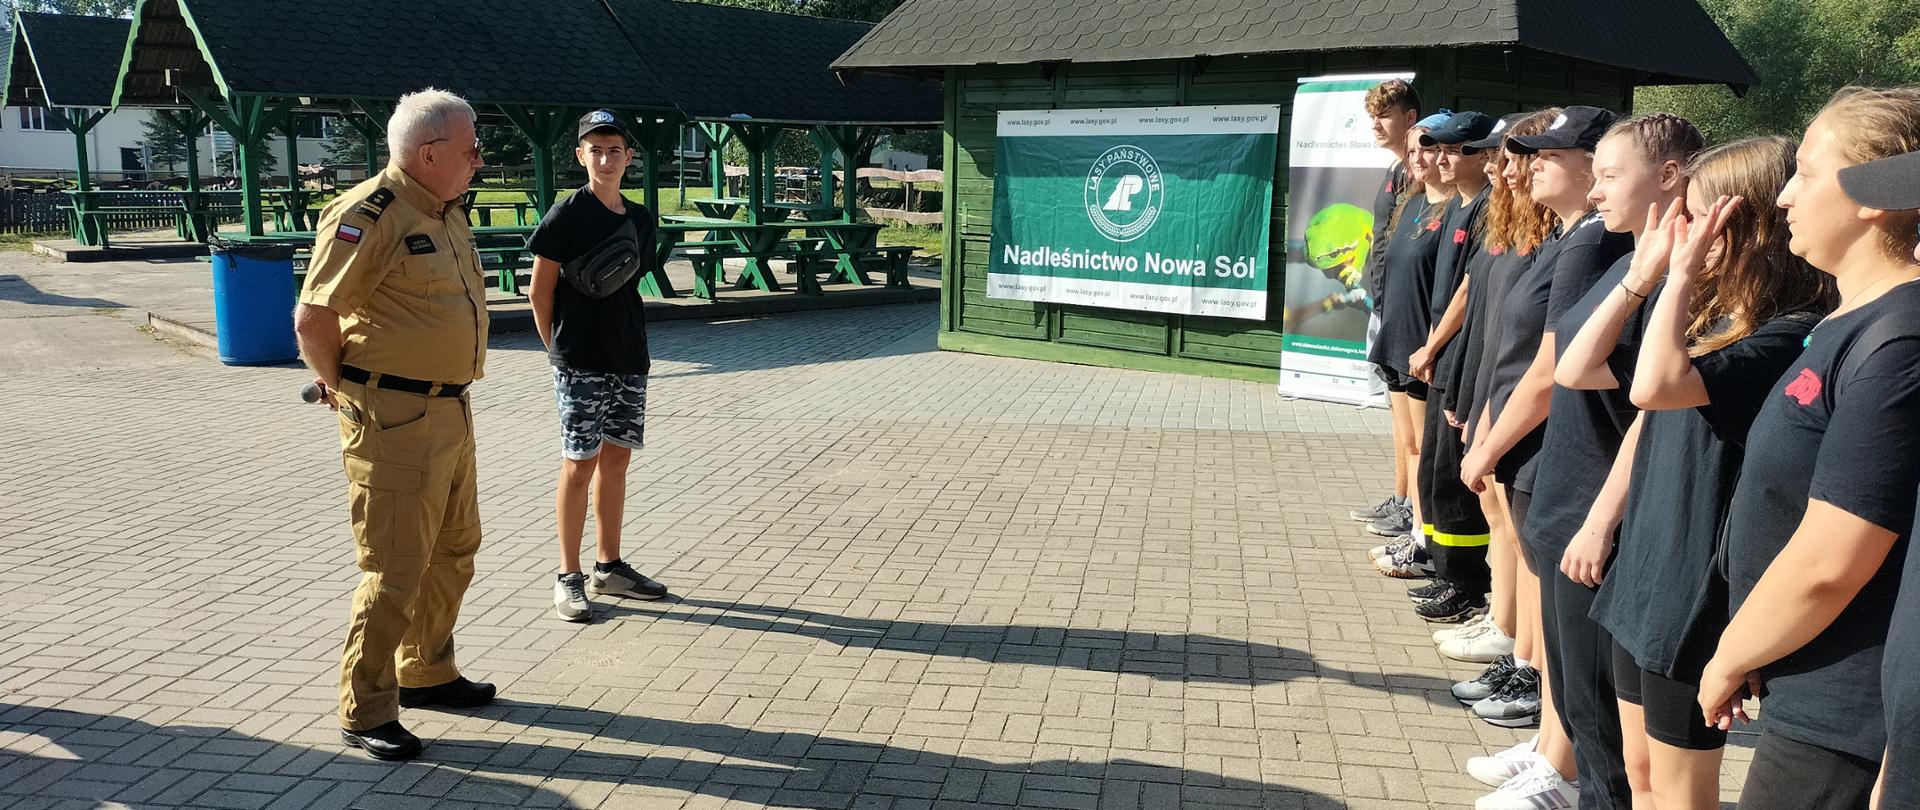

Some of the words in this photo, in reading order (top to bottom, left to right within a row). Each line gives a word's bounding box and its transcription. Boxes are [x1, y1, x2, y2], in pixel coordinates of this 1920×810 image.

[1007, 119, 1051, 127] www.lasy.gov.pl
[1069, 117, 1118, 126] www.lasy.gov.pl
[1138, 115, 1190, 125] www.lasy.gov.pl
[1212, 114, 1268, 123] www.lasy.gov.pl
[1088, 160, 1107, 191] LASY
[1106, 148, 1160, 192] PAŃSTWOWE
[1003, 244, 1139, 272] Nadleśnictwo
[1144, 251, 1207, 277] Nowa
[1214, 255, 1256, 279] Sól
[998, 283, 1047, 293] www.lasy.gov.pl
[1065, 287, 1111, 298] www.lasy.gov.pl
[1129, 292, 1179, 303] www.lasy.gov.pl
[1201, 298, 1257, 309] www.lasy.gov.pl
